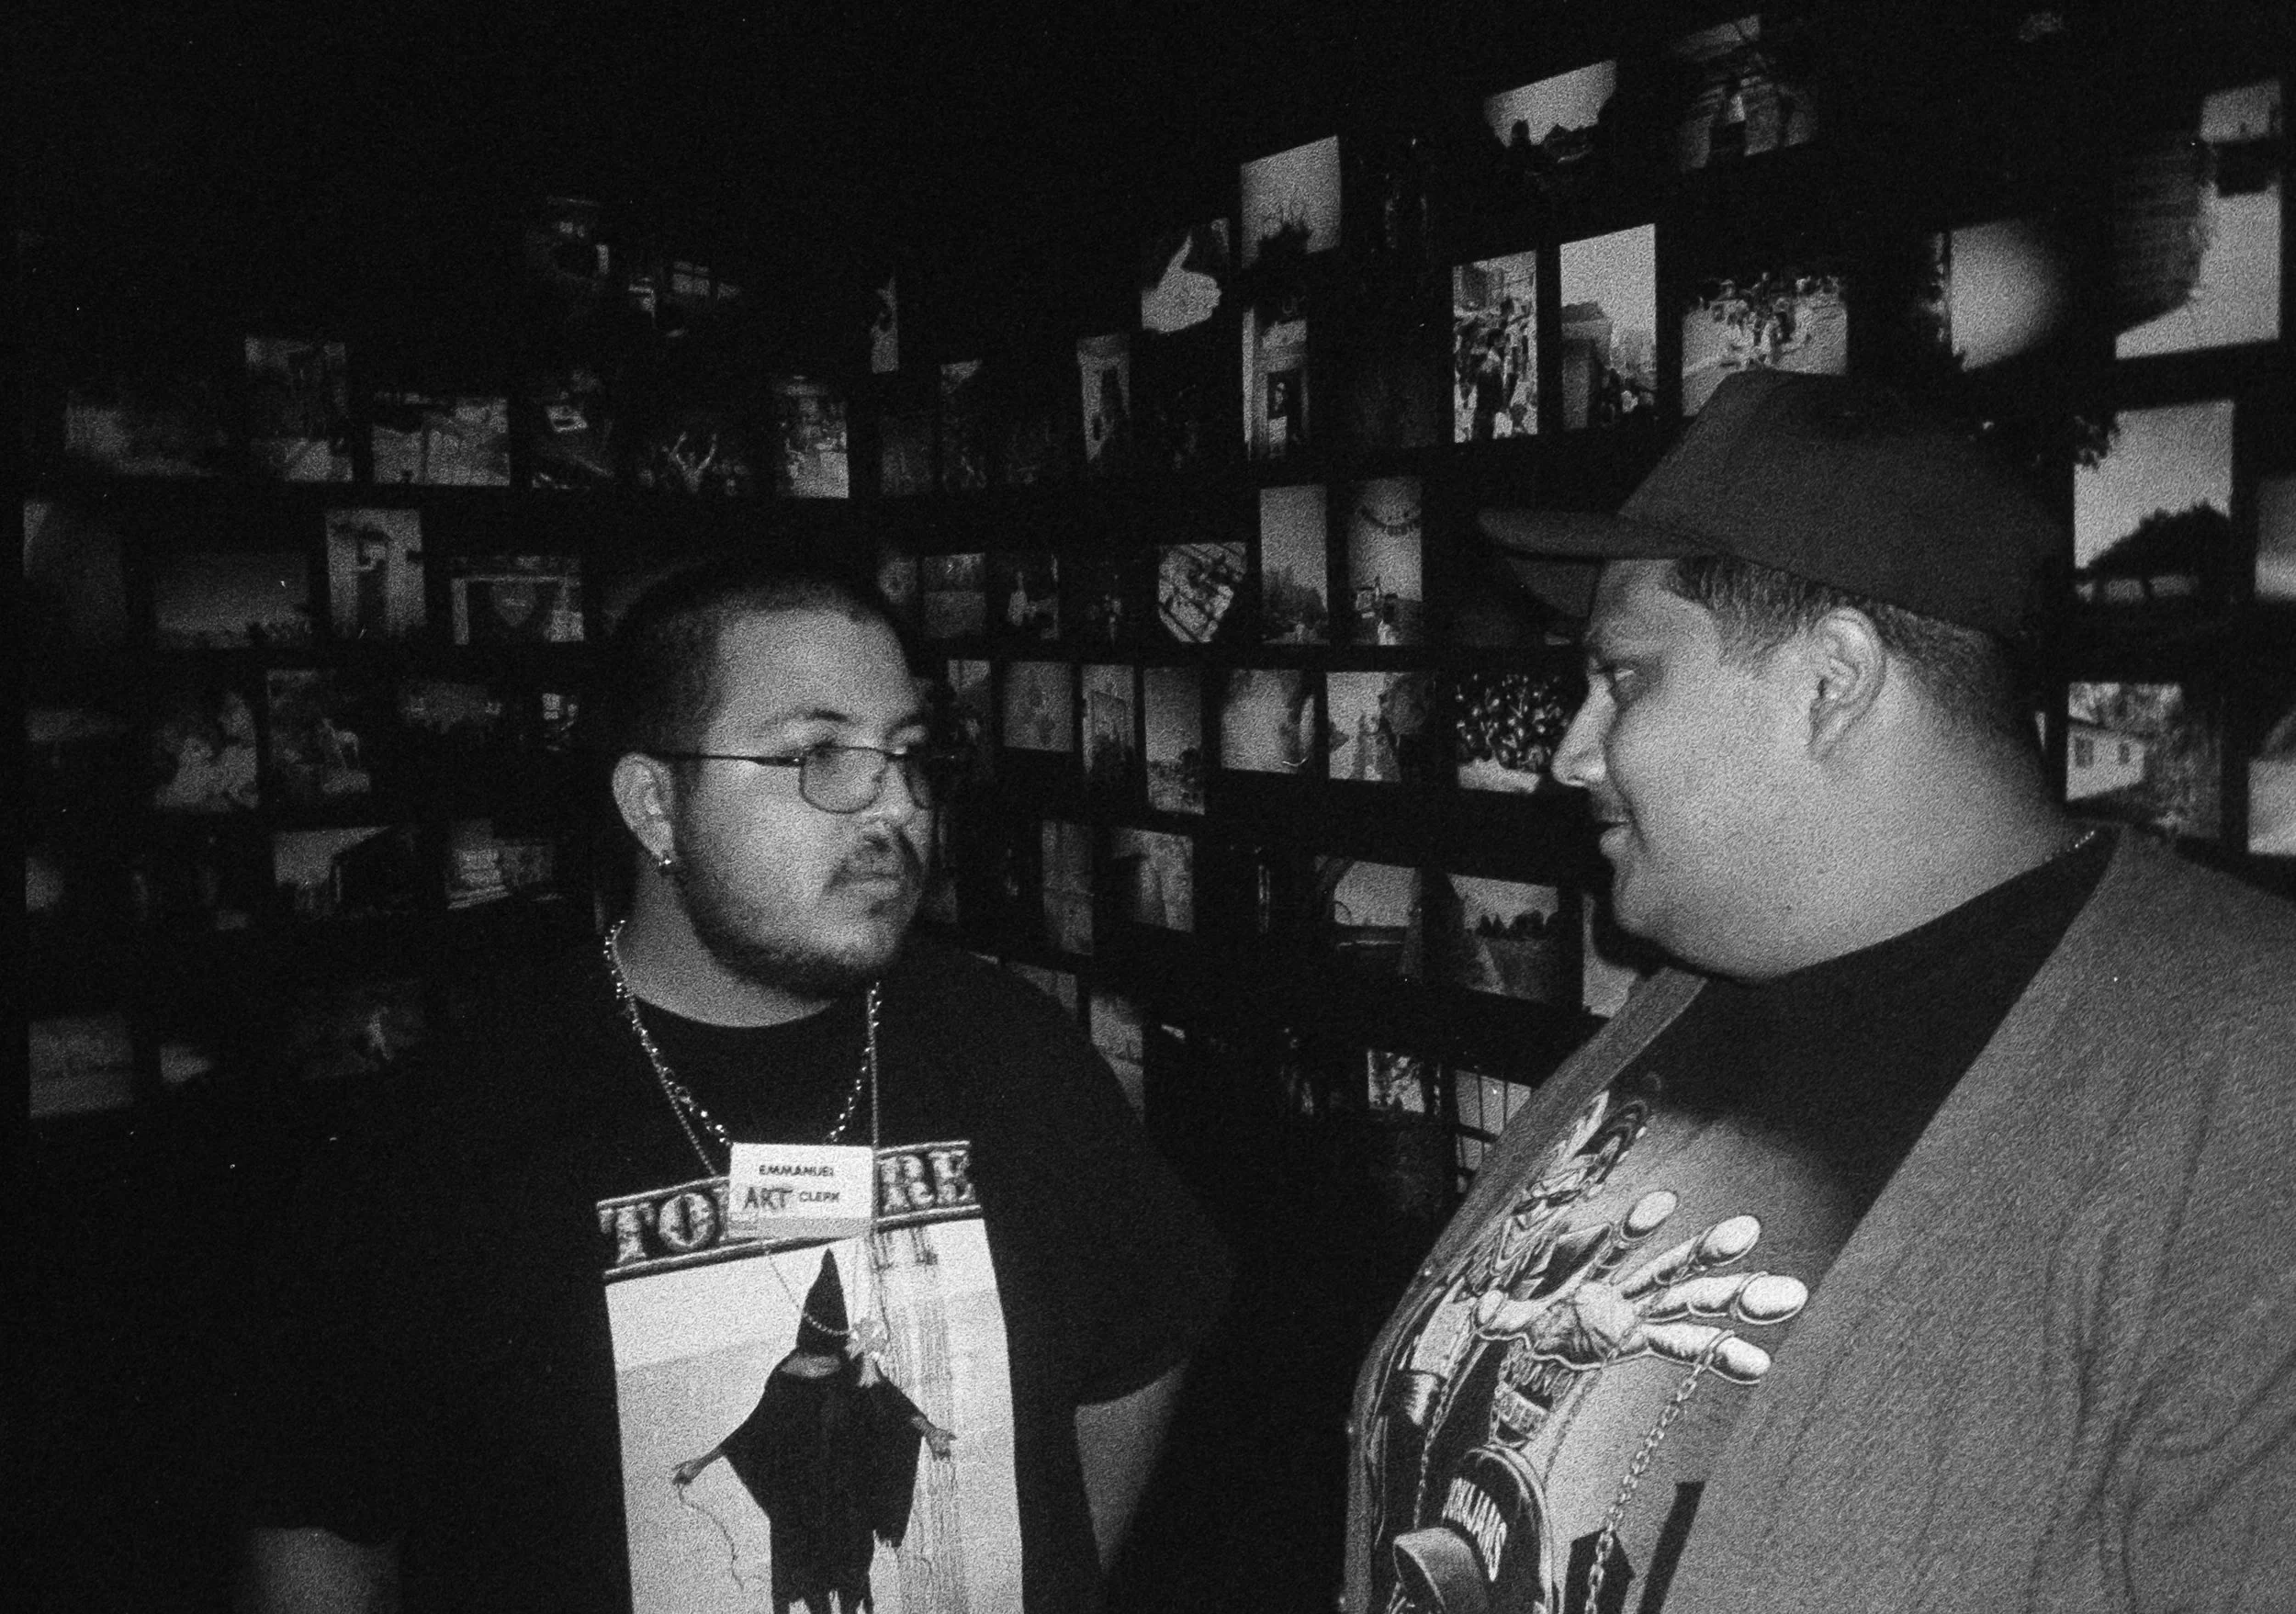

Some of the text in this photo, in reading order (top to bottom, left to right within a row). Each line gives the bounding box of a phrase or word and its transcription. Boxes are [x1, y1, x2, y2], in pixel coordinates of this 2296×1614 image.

[759, 1164, 834, 1177] EMMANUEL
[744, 1186, 840, 1211] ART CLERK
